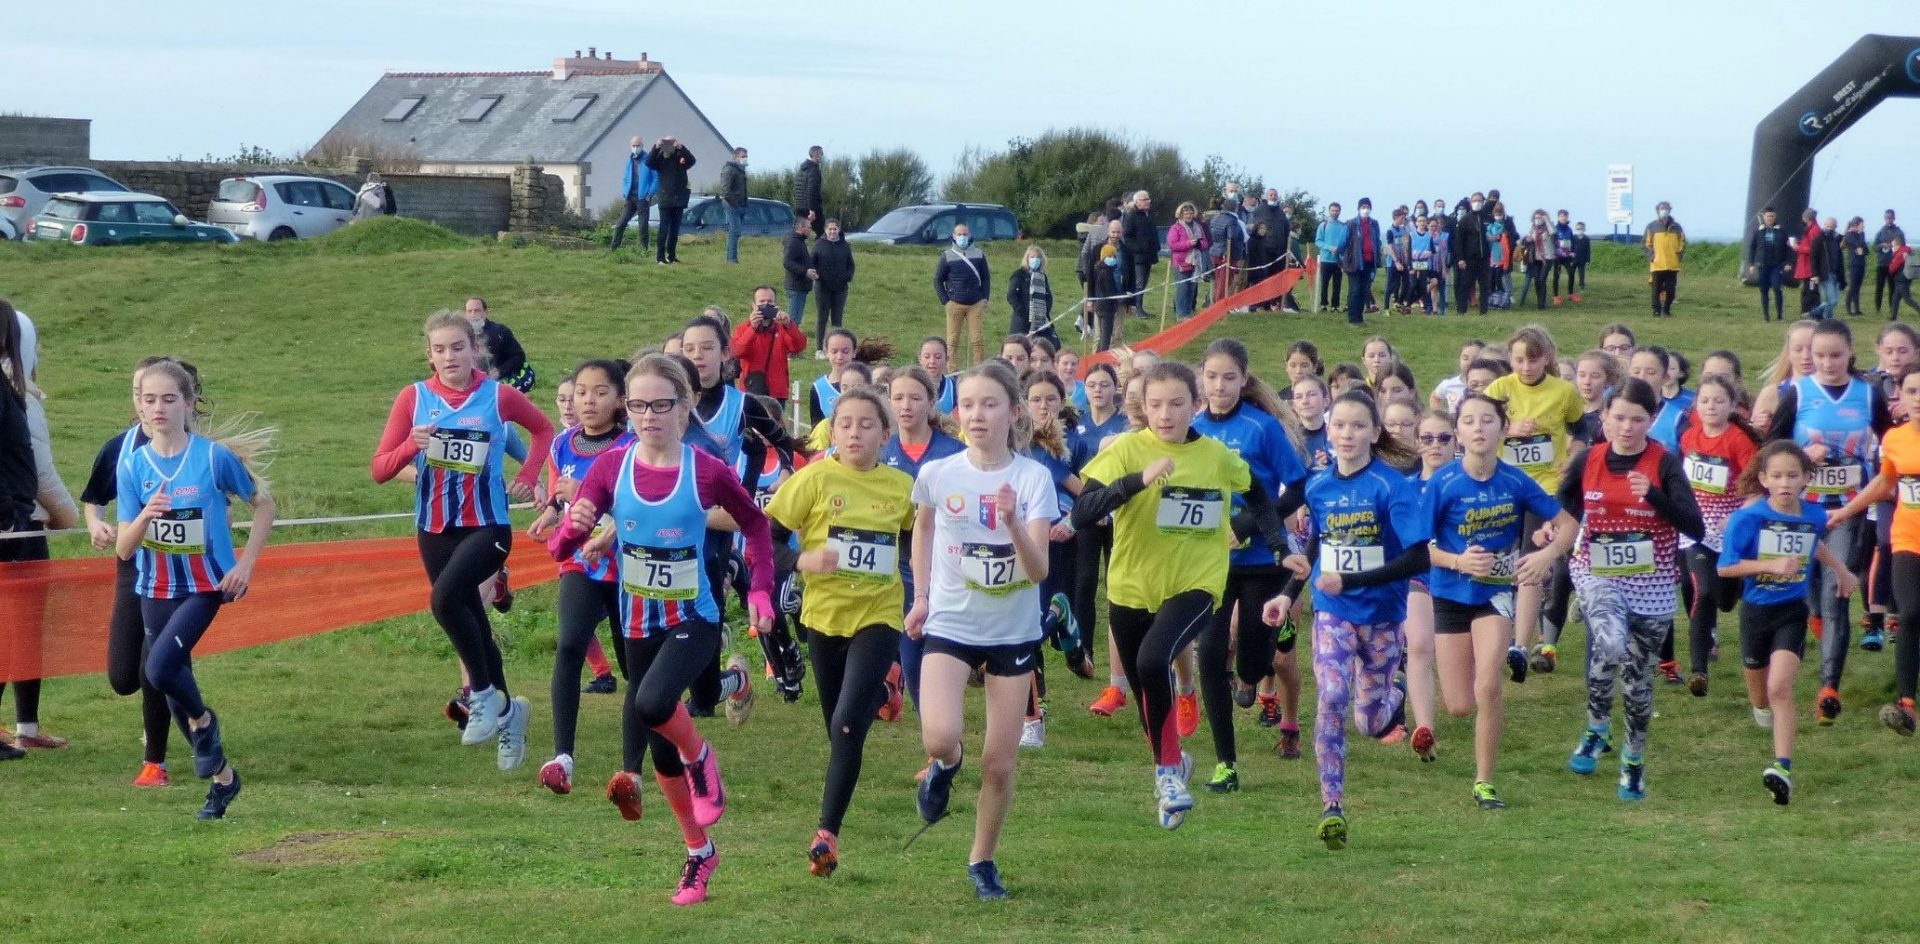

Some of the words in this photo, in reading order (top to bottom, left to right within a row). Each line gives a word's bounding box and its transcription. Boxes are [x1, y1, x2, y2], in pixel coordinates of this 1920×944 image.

[1833, 80, 1856, 102] BREST
[442, 441, 474, 462] 139
[1513, 445, 1541, 464] 126
[1691, 462, 1713, 484] 104
[1820, 468, 1847, 486] 169
[1179, 502, 1205, 526] 76
[1326, 511, 1375, 531] QUIMPER
[1464, 503, 1514, 523] QUIMPER
[152, 520, 186, 545] 129
[1776, 533, 1803, 554] 135
[848, 545, 877, 571] 94
[1334, 548, 1363, 572] 121
[1603, 545, 1637, 566] 159
[644, 562, 673, 588] 75
[983, 558, 1016, 586] 127
